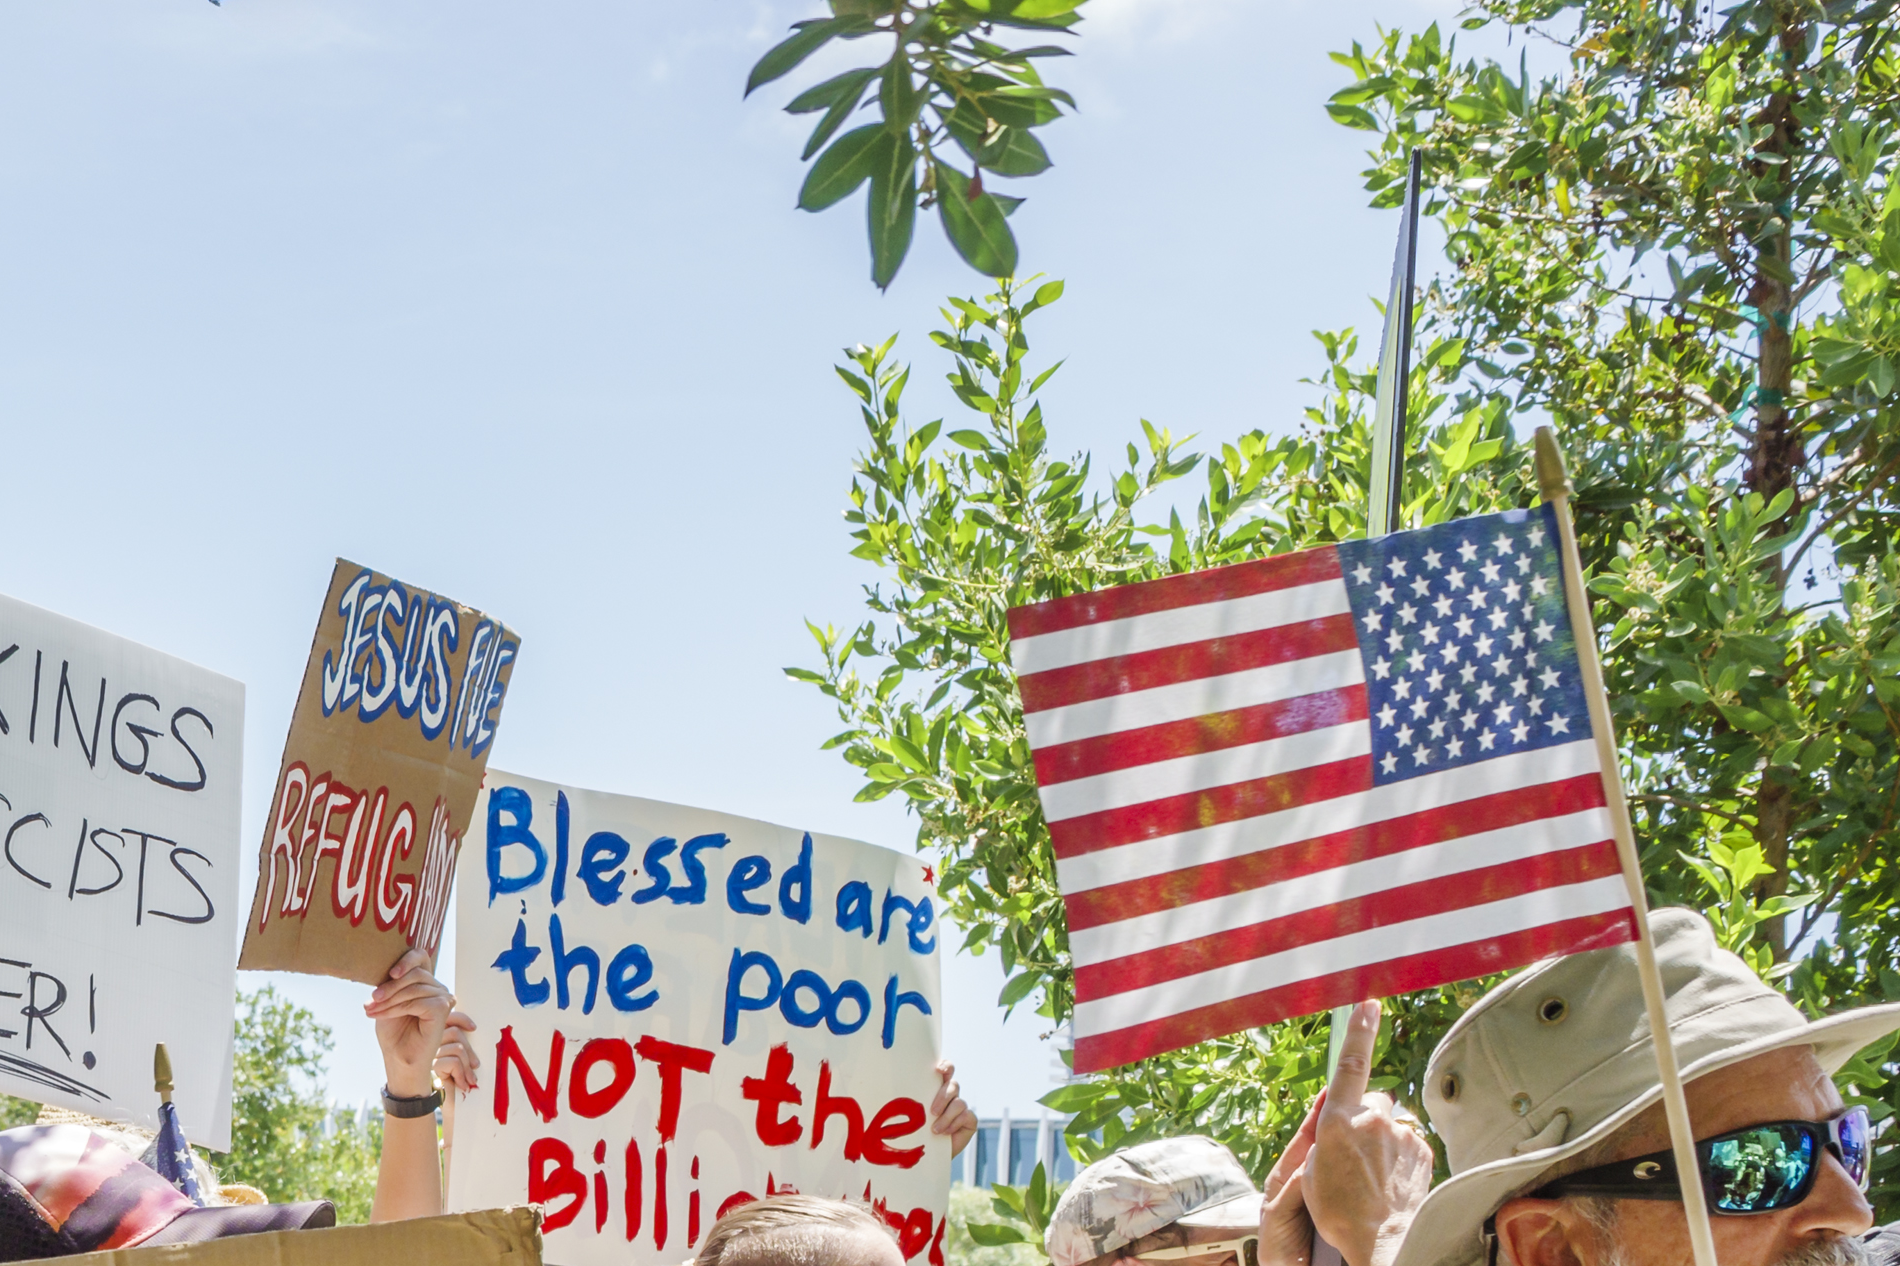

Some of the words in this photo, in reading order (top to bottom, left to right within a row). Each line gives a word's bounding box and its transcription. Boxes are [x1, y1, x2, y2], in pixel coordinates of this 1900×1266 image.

[321, 568, 459, 742] JESUS
[487, 787, 812, 925] Blessed
[835, 877, 937, 956] are
[492, 906, 660, 1015] the
[722, 948, 933, 1049] poor
[493, 1024, 716, 1143] NOT
[741, 1041, 926, 1168] the
